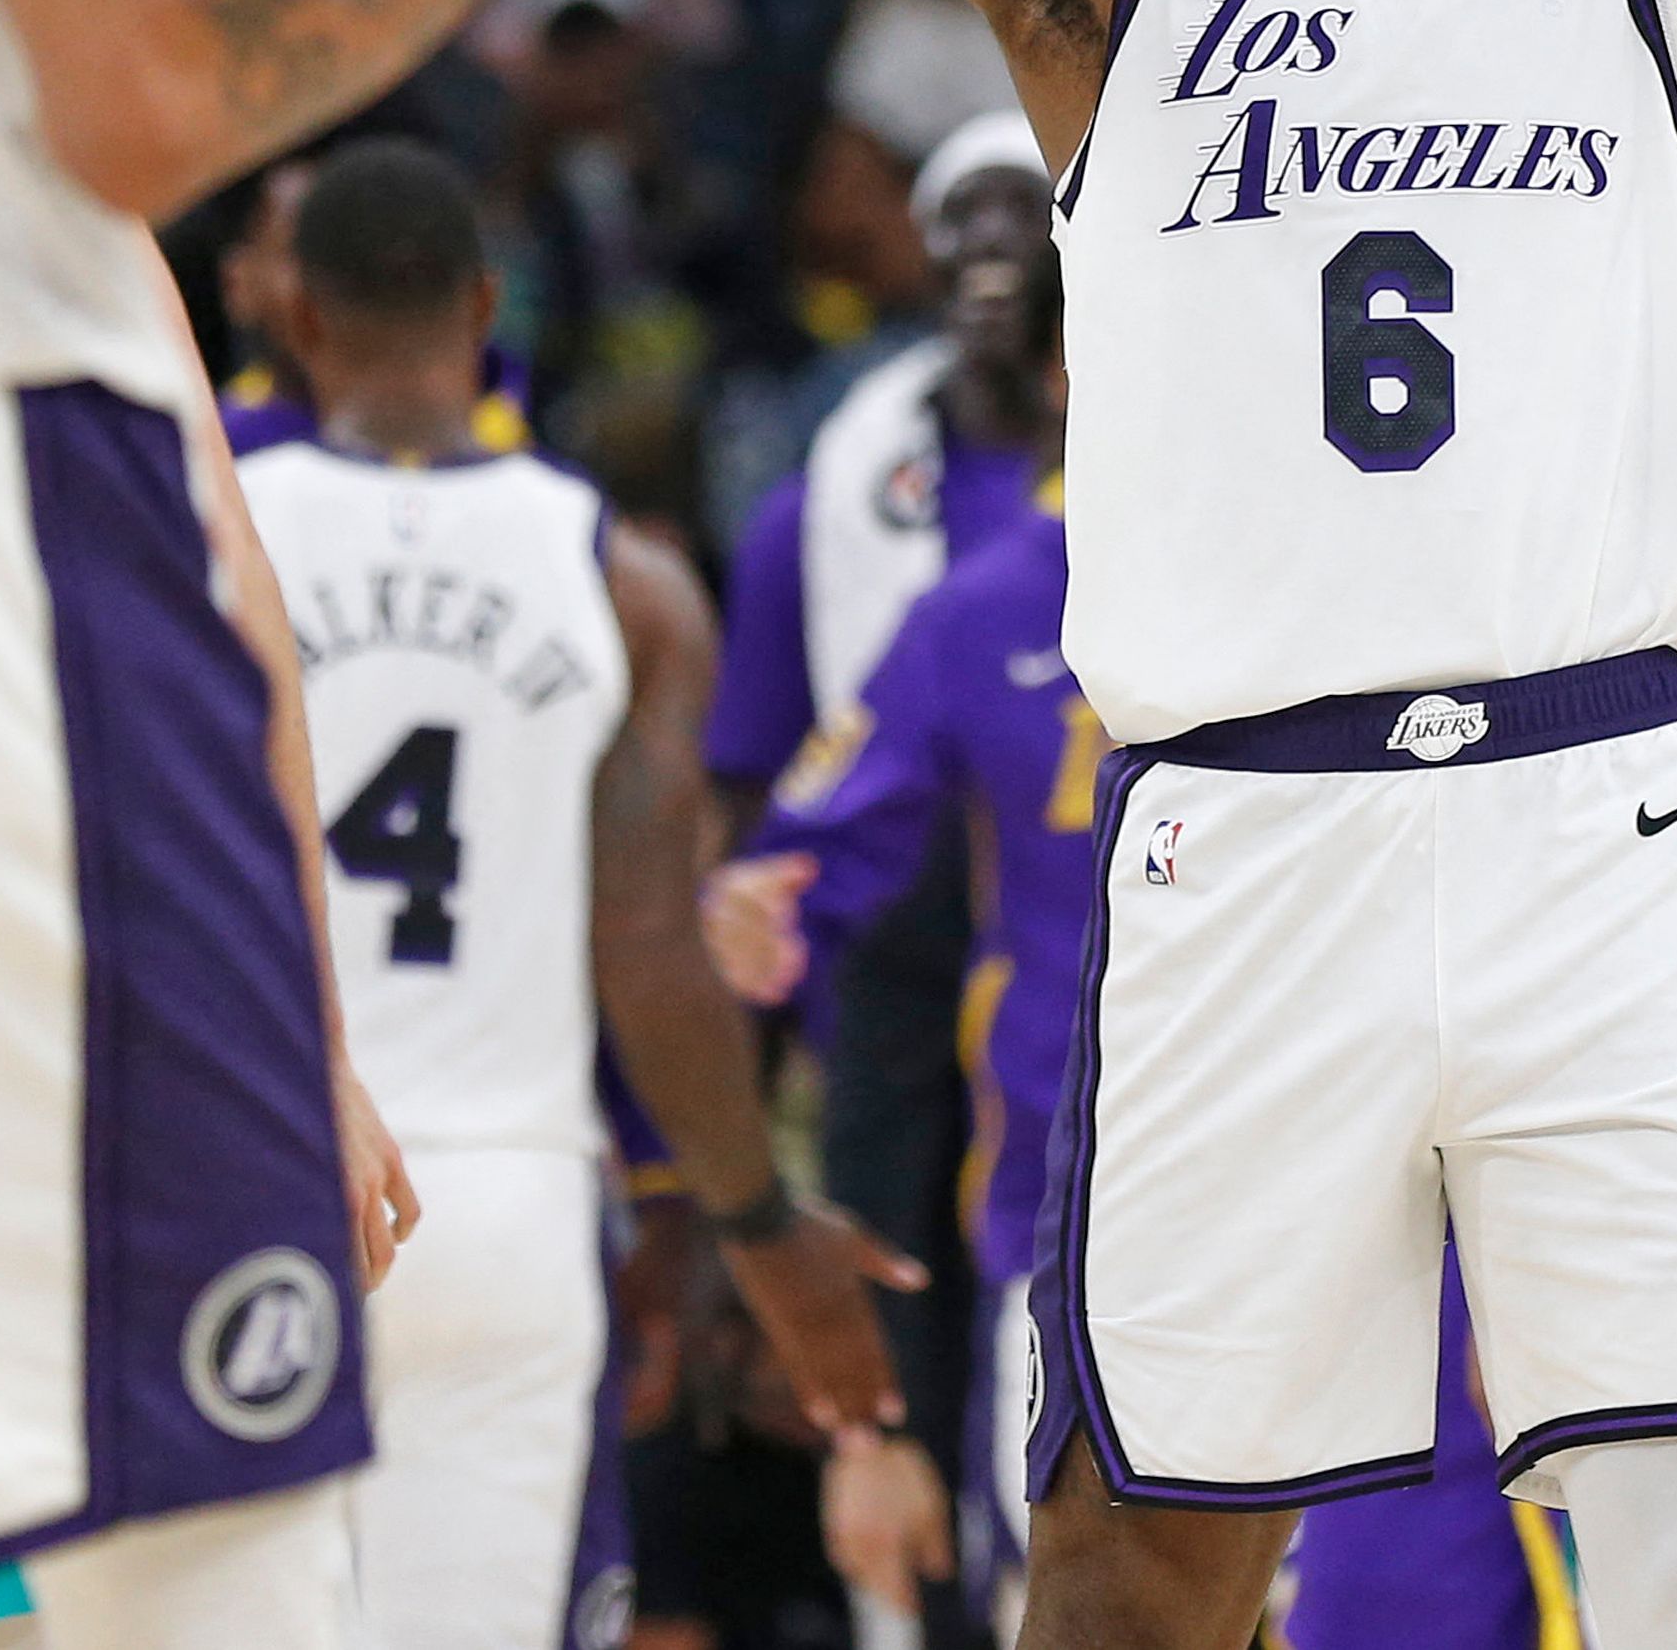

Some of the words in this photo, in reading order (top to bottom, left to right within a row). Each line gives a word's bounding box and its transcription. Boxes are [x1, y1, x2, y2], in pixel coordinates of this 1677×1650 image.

[1159, 98, 1619, 234] ANGELES
[1321, 230, 1455, 474] 6
[1390, 714, 1481, 746] LAKERS
[327, 725, 463, 966] 4
